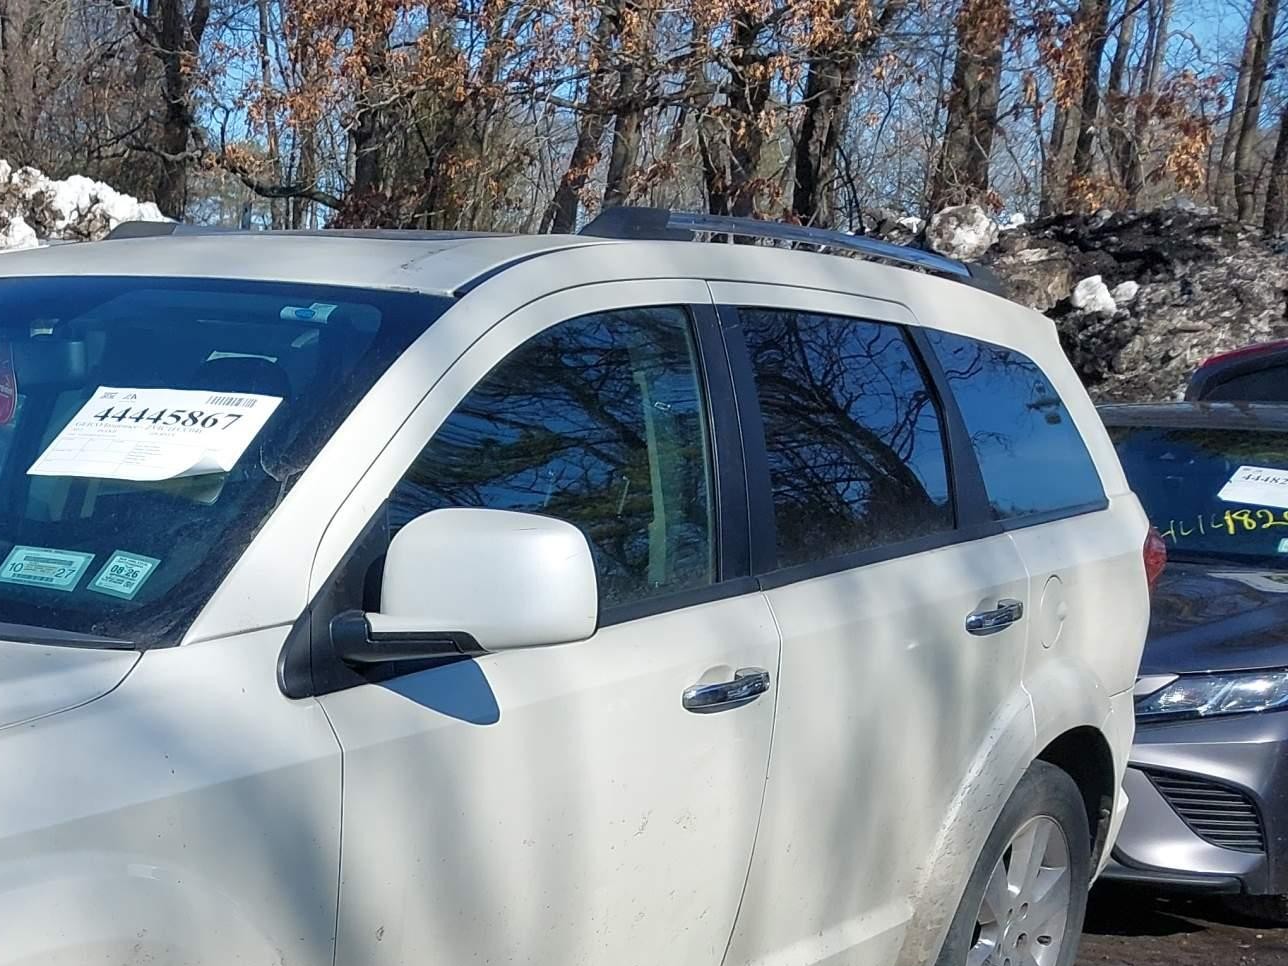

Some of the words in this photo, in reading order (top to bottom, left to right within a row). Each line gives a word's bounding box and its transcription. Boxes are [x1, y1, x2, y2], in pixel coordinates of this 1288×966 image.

[93, 406, 244, 431] 44445867
[8, 562, 24, 573] 10
[54, 568, 76, 579] 27
